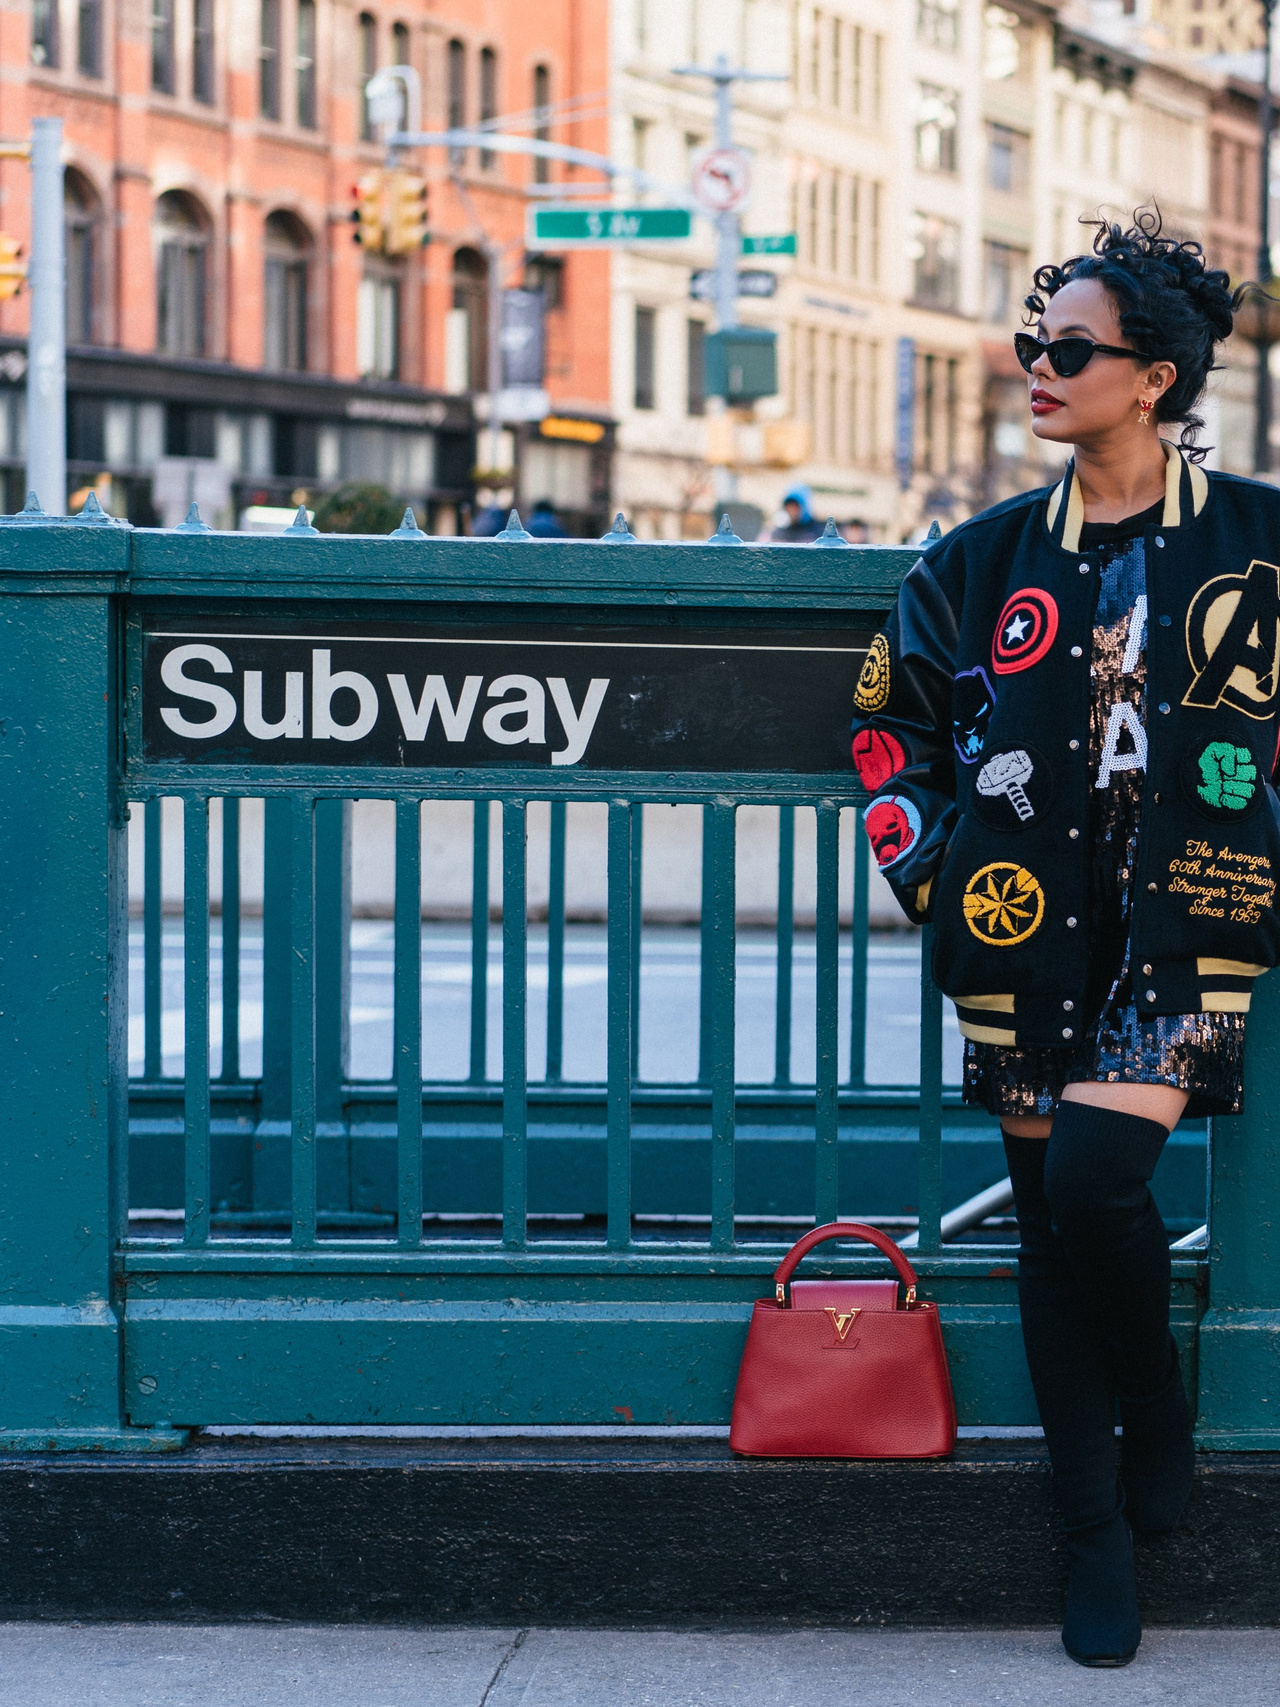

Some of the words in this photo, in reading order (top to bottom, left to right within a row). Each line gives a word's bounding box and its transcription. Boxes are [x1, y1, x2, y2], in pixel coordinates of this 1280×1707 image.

[159, 643, 611, 767] Subway
[1186, 839, 1214, 858] The
[1169, 859, 1202, 876] 60th
[1168, 876, 1228, 906] Stronger
[1189, 898, 1225, 918] Since
[1229, 907, 1262, 925] 1963
